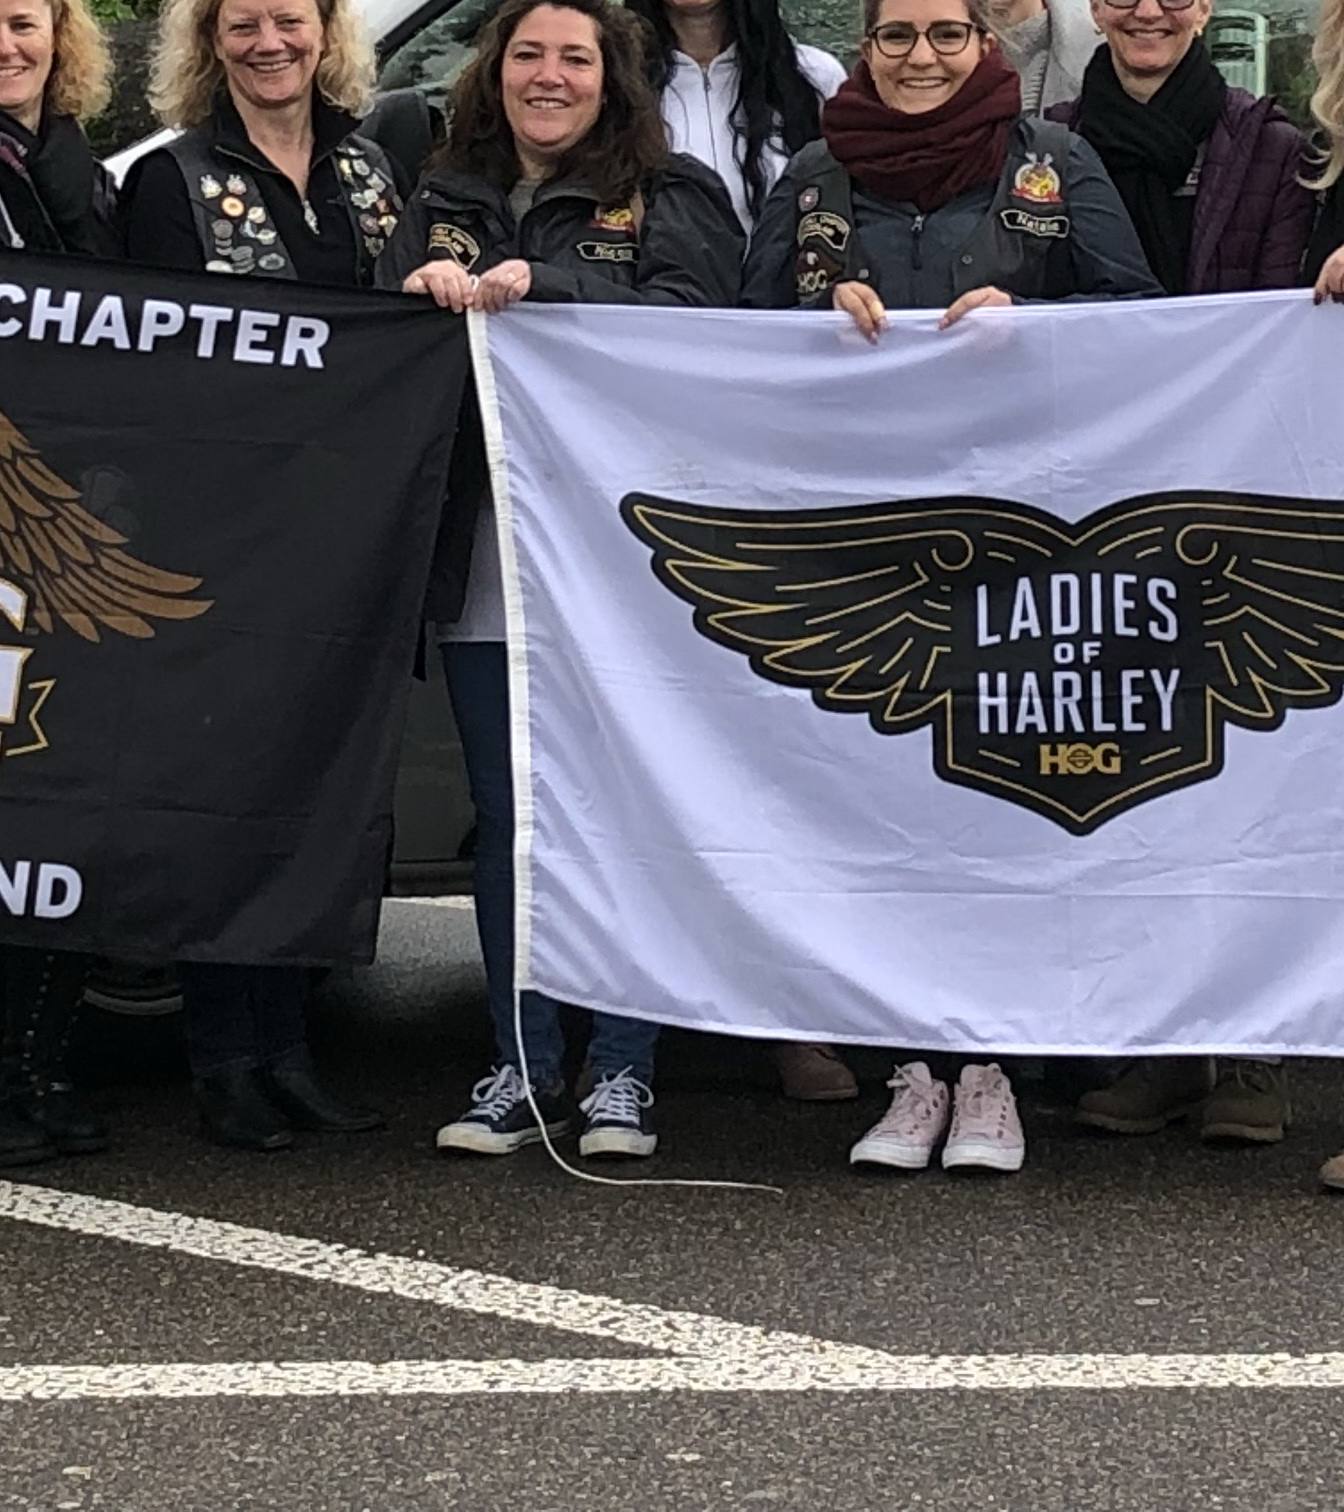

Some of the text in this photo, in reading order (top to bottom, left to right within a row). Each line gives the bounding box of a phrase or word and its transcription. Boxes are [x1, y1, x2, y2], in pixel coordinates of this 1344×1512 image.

[976, 573, 1178, 646] LADIES
[1054, 642, 1102, 664] OF
[977, 668, 1180, 734] HARLEY
[1039, 742, 1122, 775] HOG
